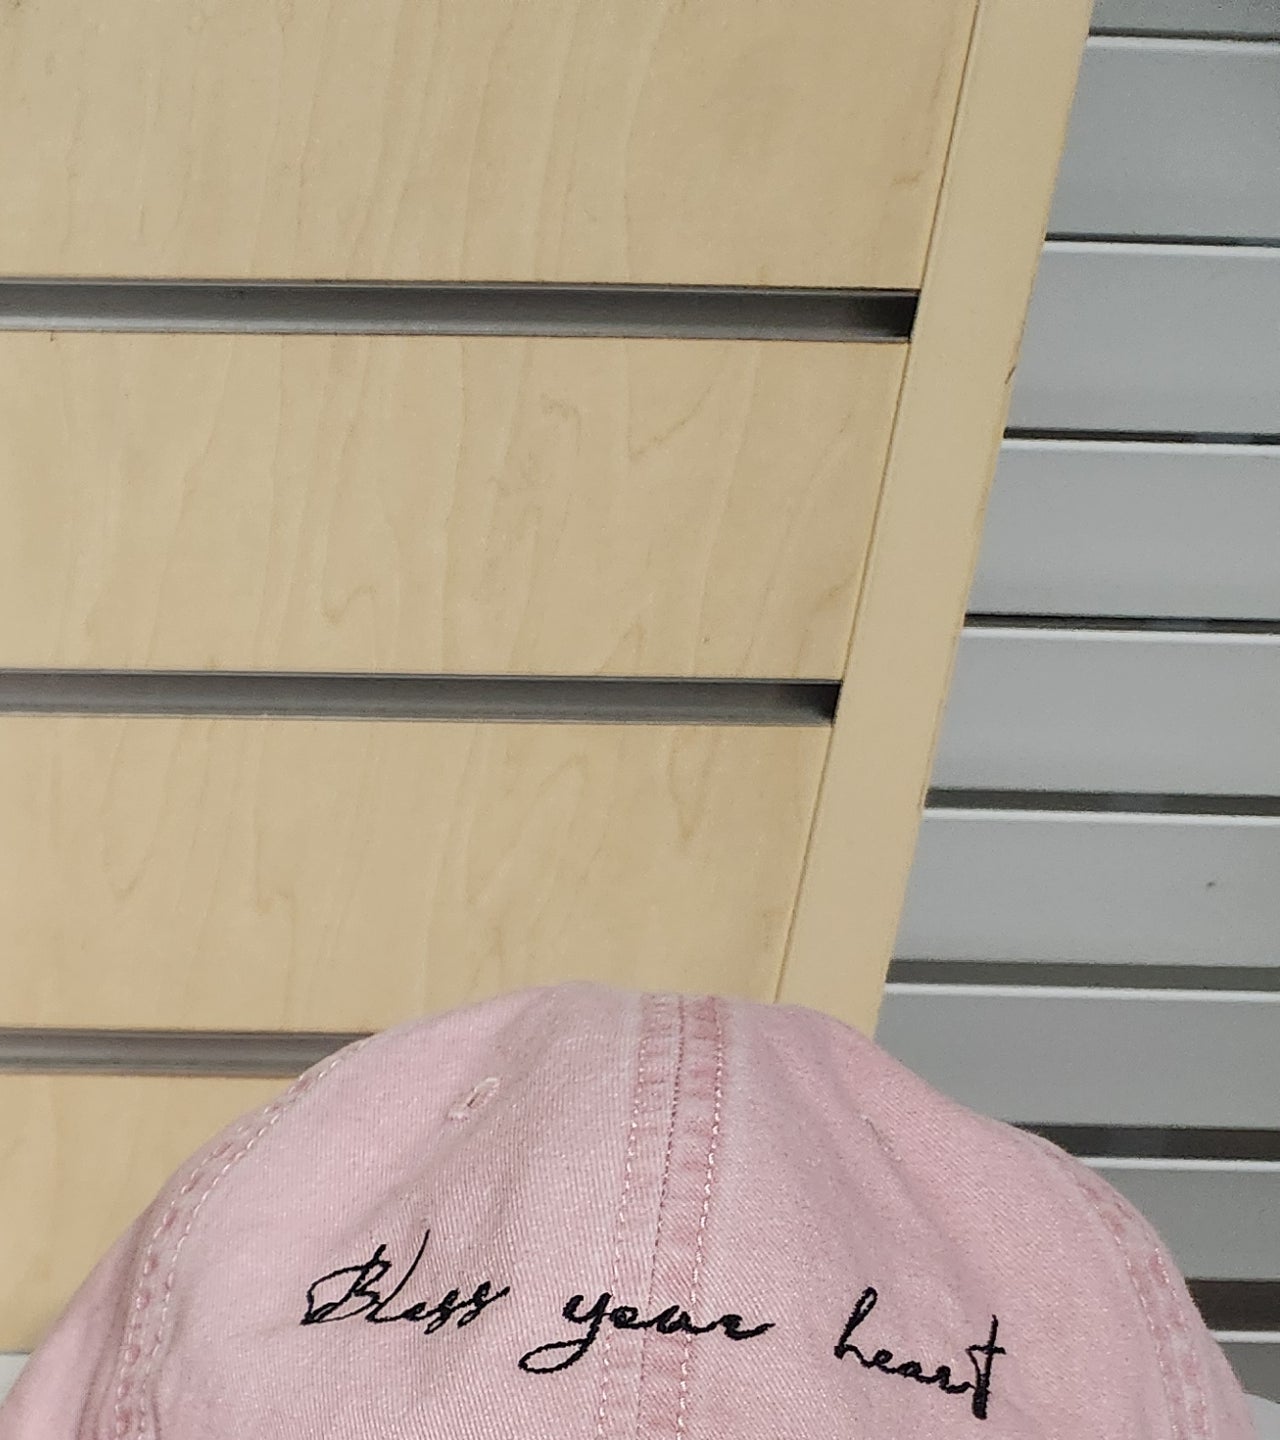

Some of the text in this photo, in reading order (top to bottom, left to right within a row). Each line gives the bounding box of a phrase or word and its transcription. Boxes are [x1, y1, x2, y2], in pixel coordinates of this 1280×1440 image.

[300, 1229, 1006, 1419] Bless your heart
